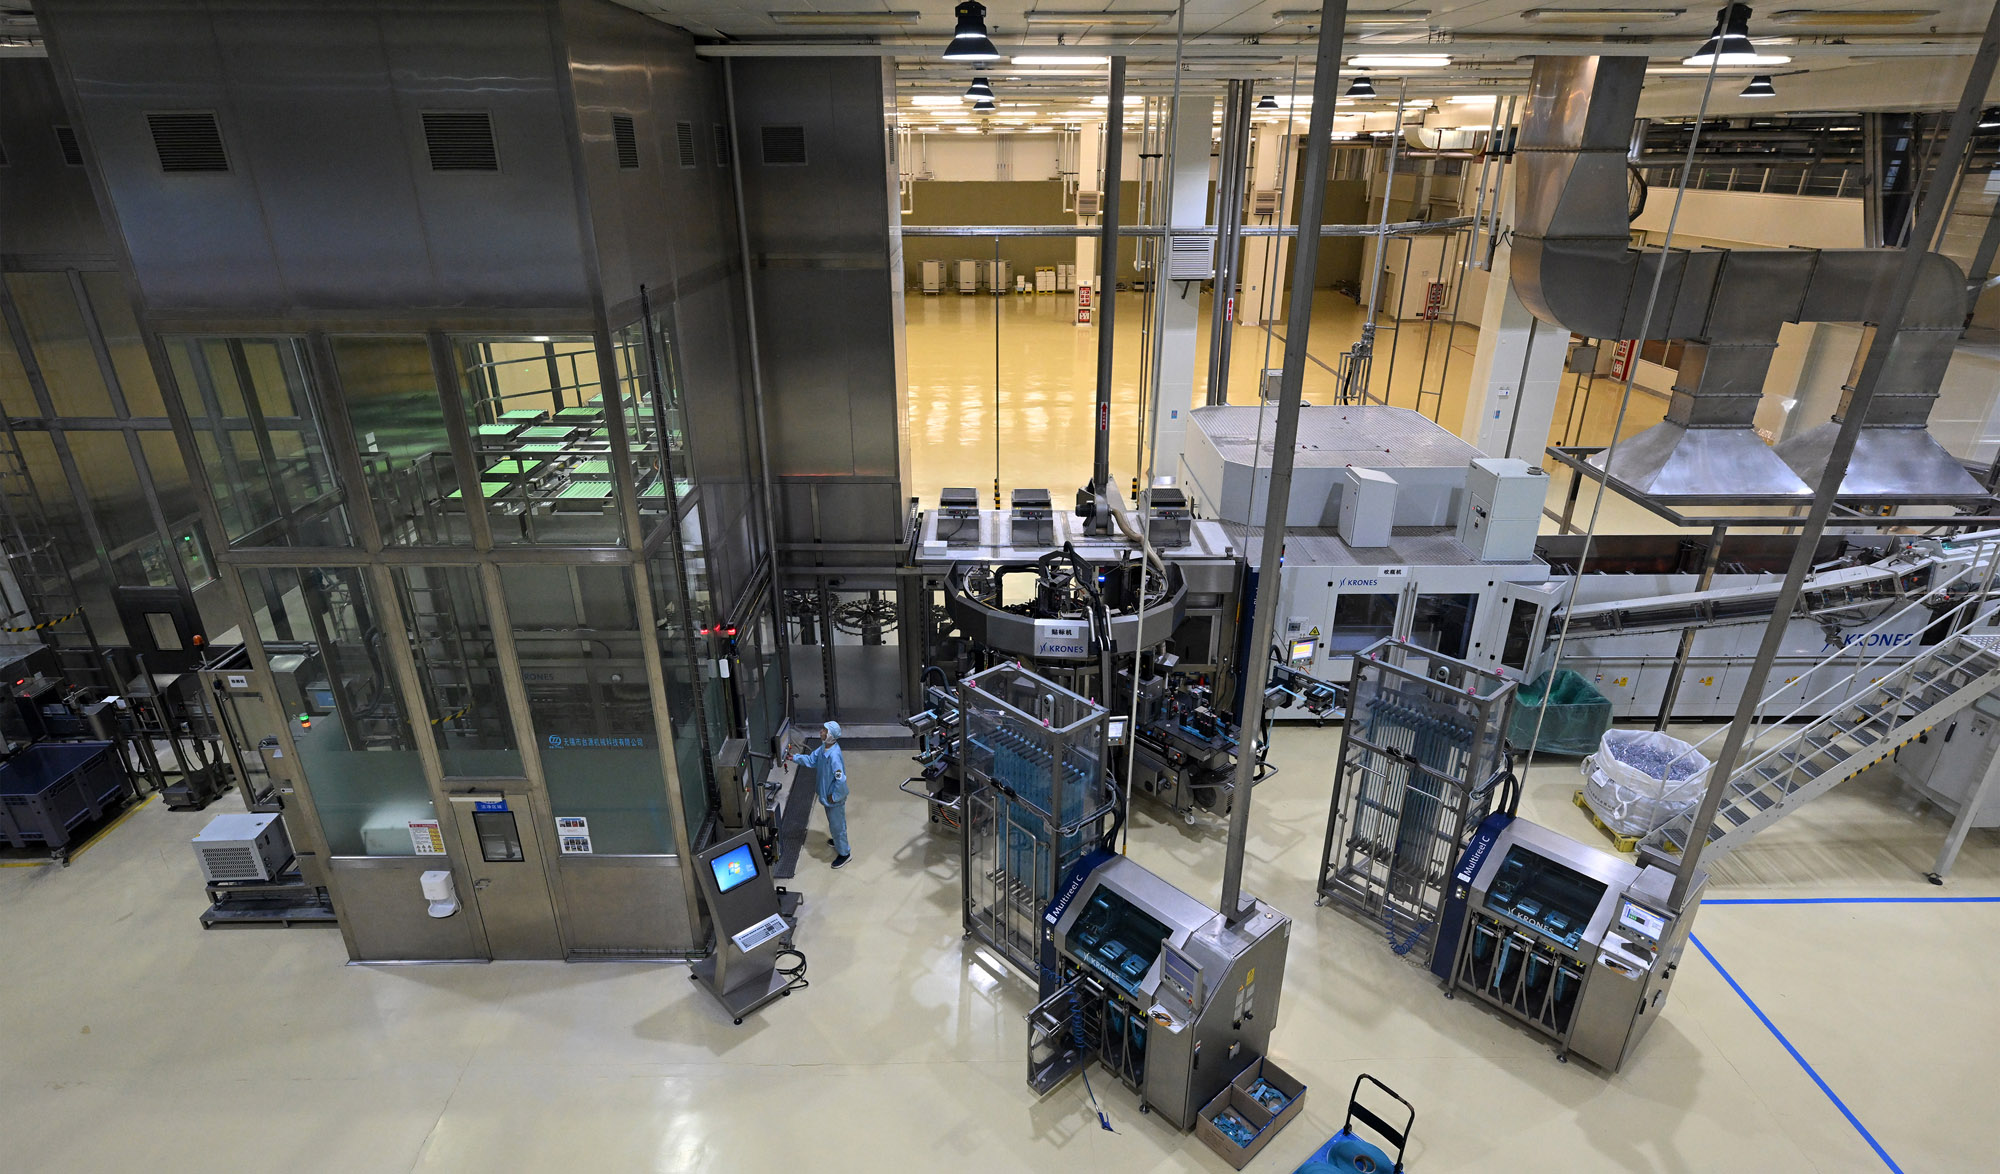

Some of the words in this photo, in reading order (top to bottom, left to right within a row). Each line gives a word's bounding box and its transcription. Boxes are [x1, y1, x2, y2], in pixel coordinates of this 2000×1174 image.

[1049, 645, 1084, 653] KRONES
[1463, 841, 1487, 876] Multireel
[1481, 835, 1490, 843] C
[1052, 880, 1079, 917] Multireel
[1075, 874, 1084, 882] C
[1517, 912, 1554, 934] KRONES
[1091, 957, 1120, 982] KRONES
